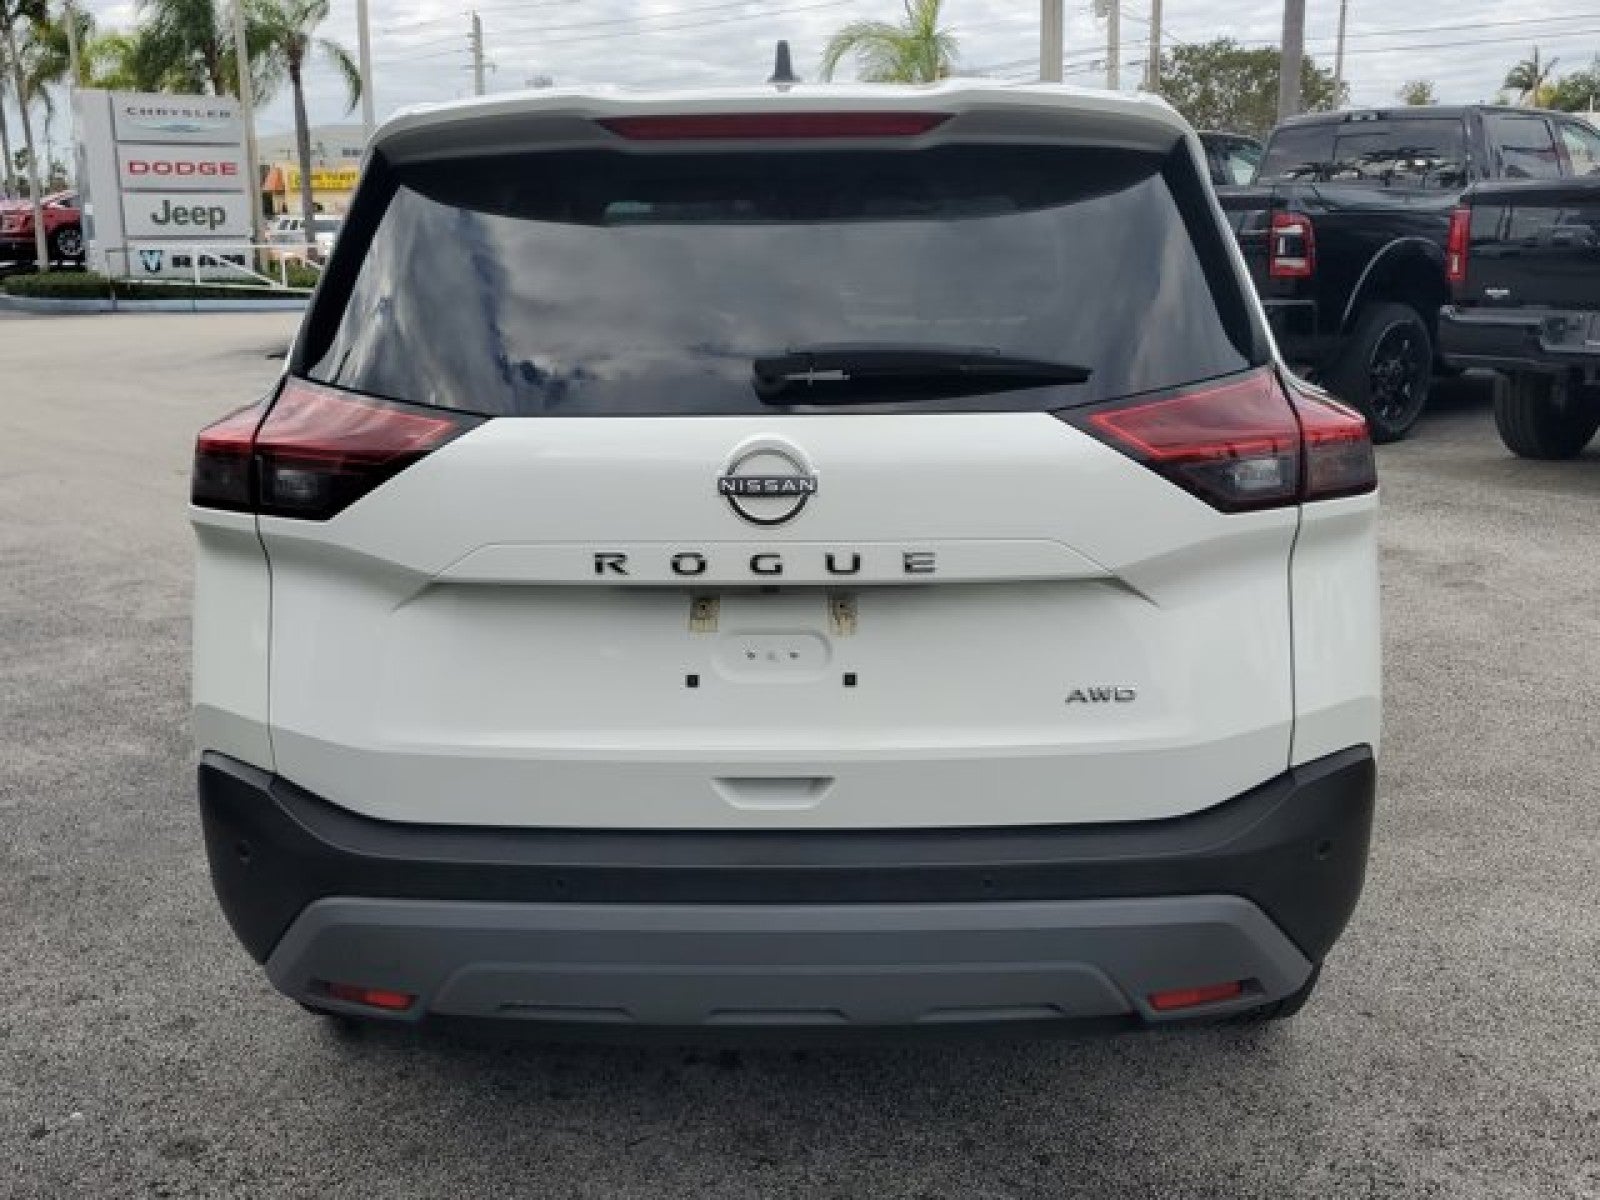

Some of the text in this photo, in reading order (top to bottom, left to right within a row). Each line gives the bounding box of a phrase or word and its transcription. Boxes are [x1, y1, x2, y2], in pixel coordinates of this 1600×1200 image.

[126, 107, 231, 118] CHRYSLER
[129, 161, 238, 175] DODGE
[151, 199, 226, 230] Jeep
[722, 479, 814, 491] NISSAN
[594, 552, 936, 575] ROGUE
[1065, 687, 1136, 703] AWD
